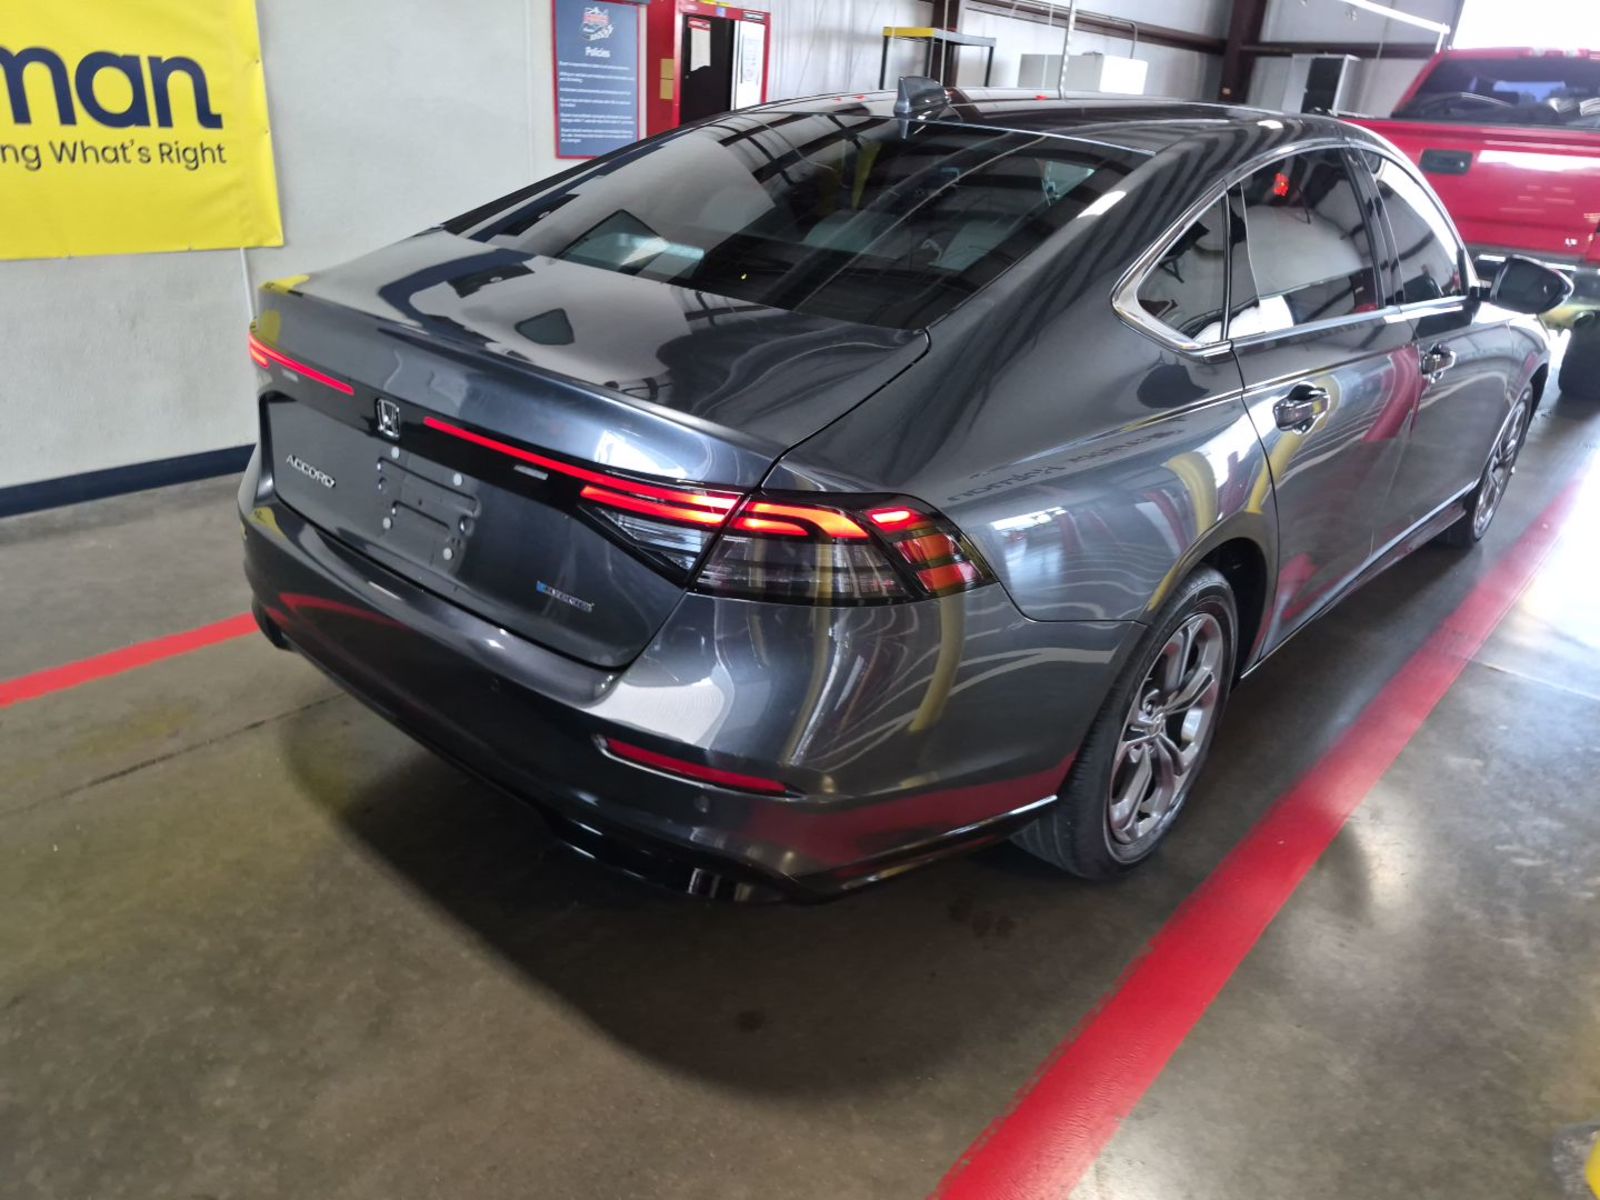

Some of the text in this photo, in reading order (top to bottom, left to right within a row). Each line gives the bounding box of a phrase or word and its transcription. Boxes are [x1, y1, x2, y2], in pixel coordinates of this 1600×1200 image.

[49, 140, 151, 164] What's
[158, 141, 227, 171] Right
[286, 454, 335, 489] ACCORD
